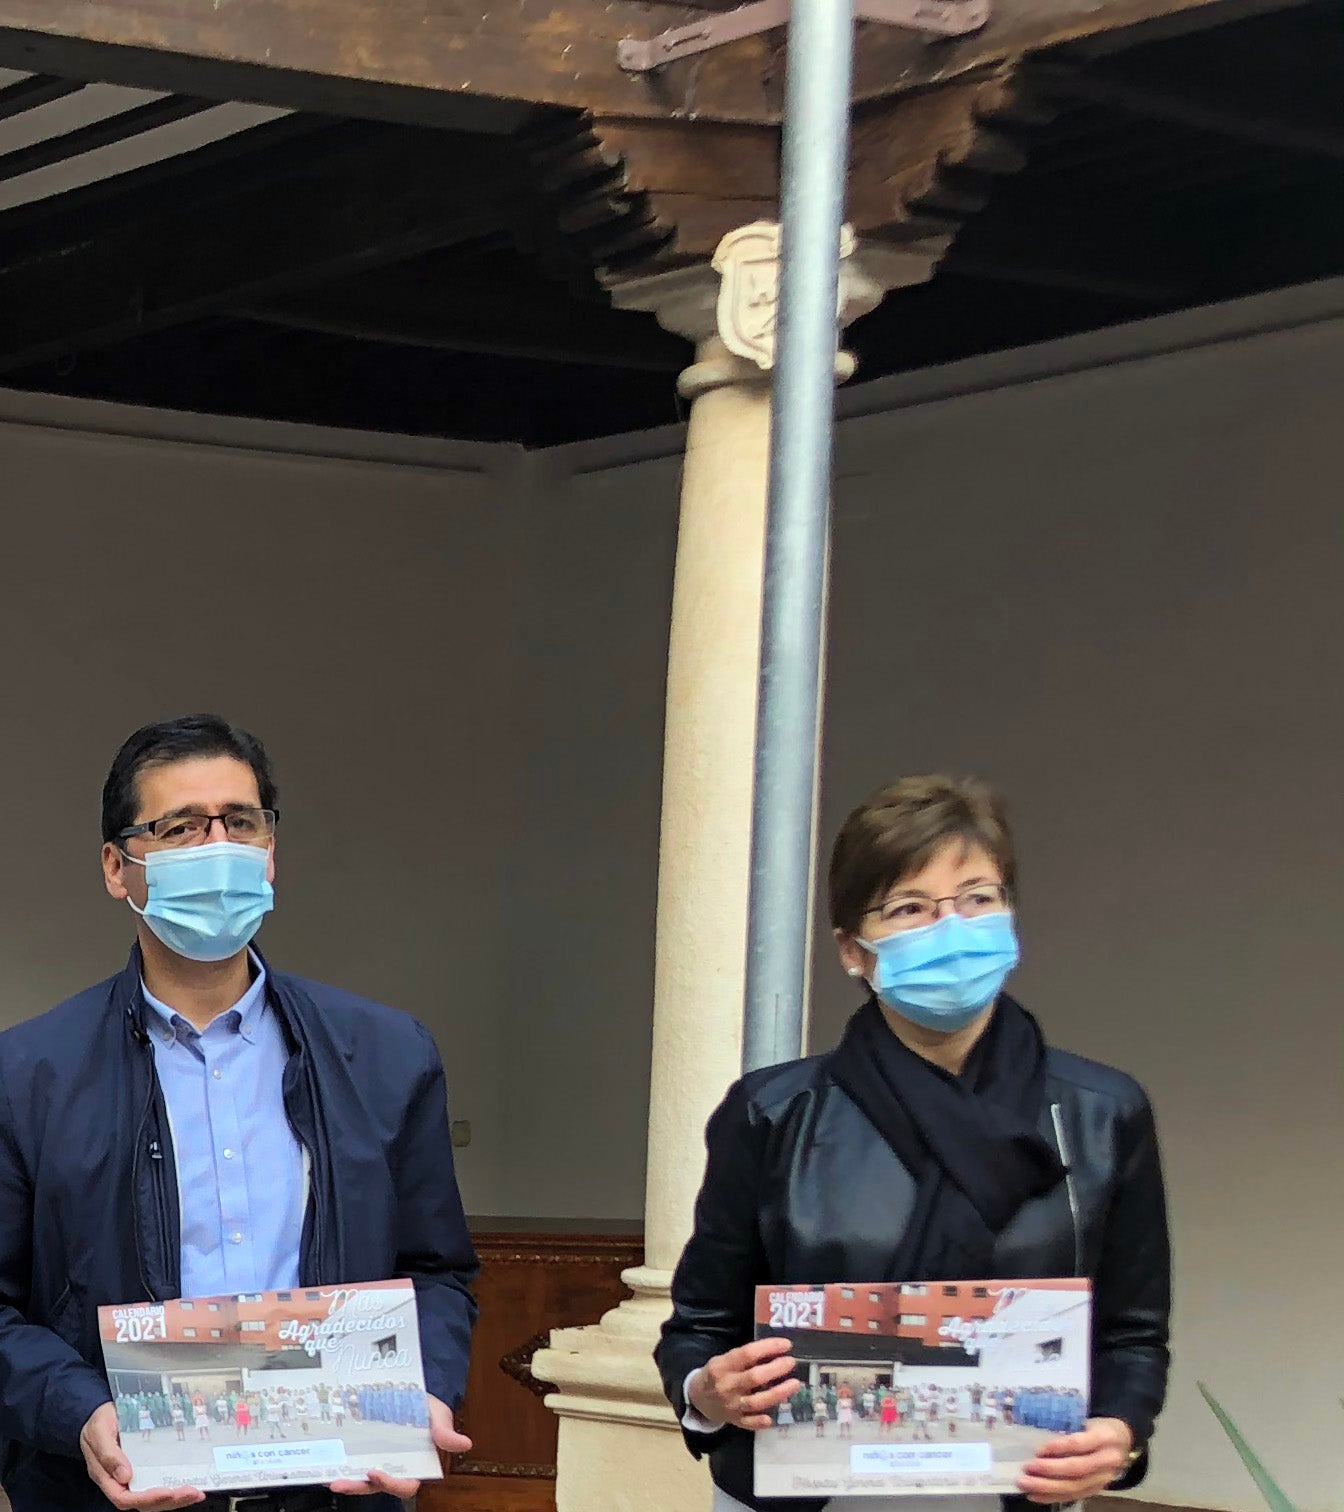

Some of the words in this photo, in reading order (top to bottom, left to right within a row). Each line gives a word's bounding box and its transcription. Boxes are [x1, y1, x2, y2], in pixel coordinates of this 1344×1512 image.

[115, 1315, 167, 1344] 2021
[278, 1315, 406, 1344] Agradecidos
[769, 1302, 823, 1328] 2021
[304, 1337, 340, 1358] que
[333, 1344, 413, 1376] Nunca
